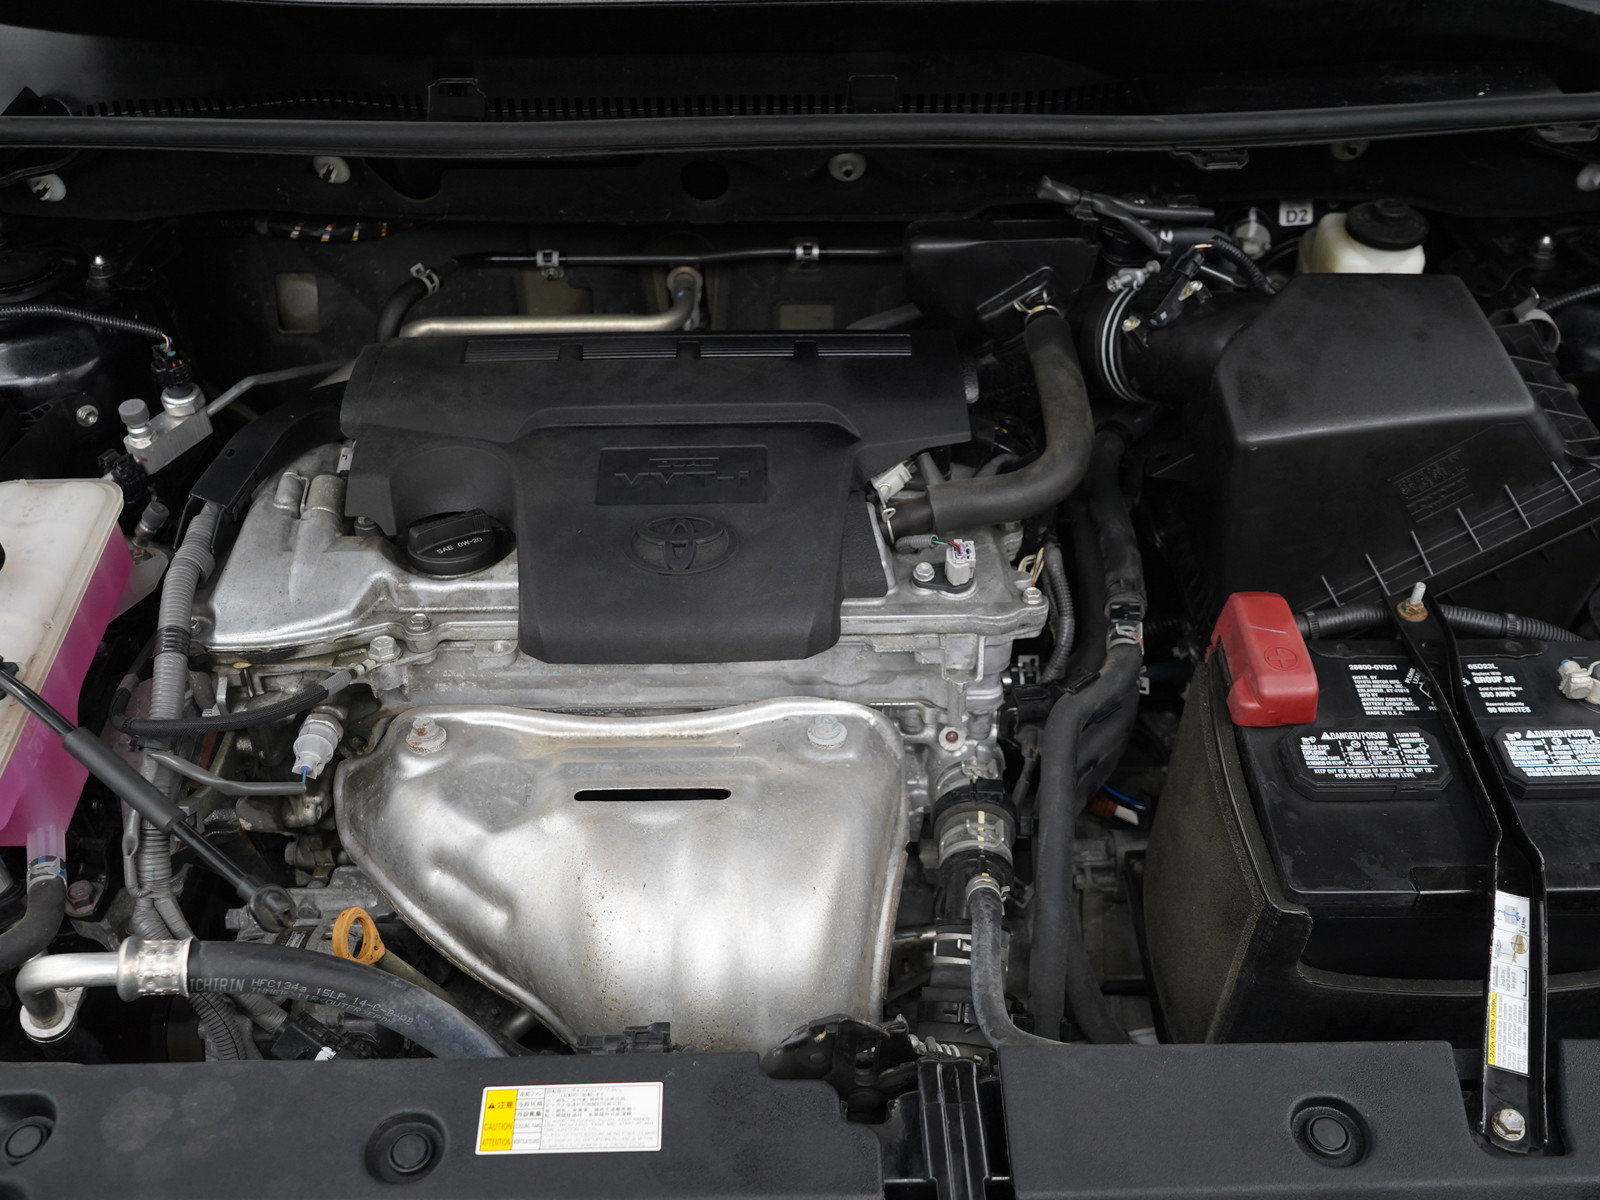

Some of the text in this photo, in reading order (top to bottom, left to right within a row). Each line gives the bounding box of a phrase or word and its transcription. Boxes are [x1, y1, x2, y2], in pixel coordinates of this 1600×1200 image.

[1286, 209, 1308, 223] D2
[436, 537, 483, 554] SAE 0W-20
[1503, 675, 1516, 683] 35
[1330, 731, 1388, 740] DANGER/POISON
[251, 979, 307, 994] HFC134a
[316, 987, 346, 1000] 15LP
[483, 1122, 513, 1132] CAUTION
[481, 1137, 511, 1147] ATTENTION
